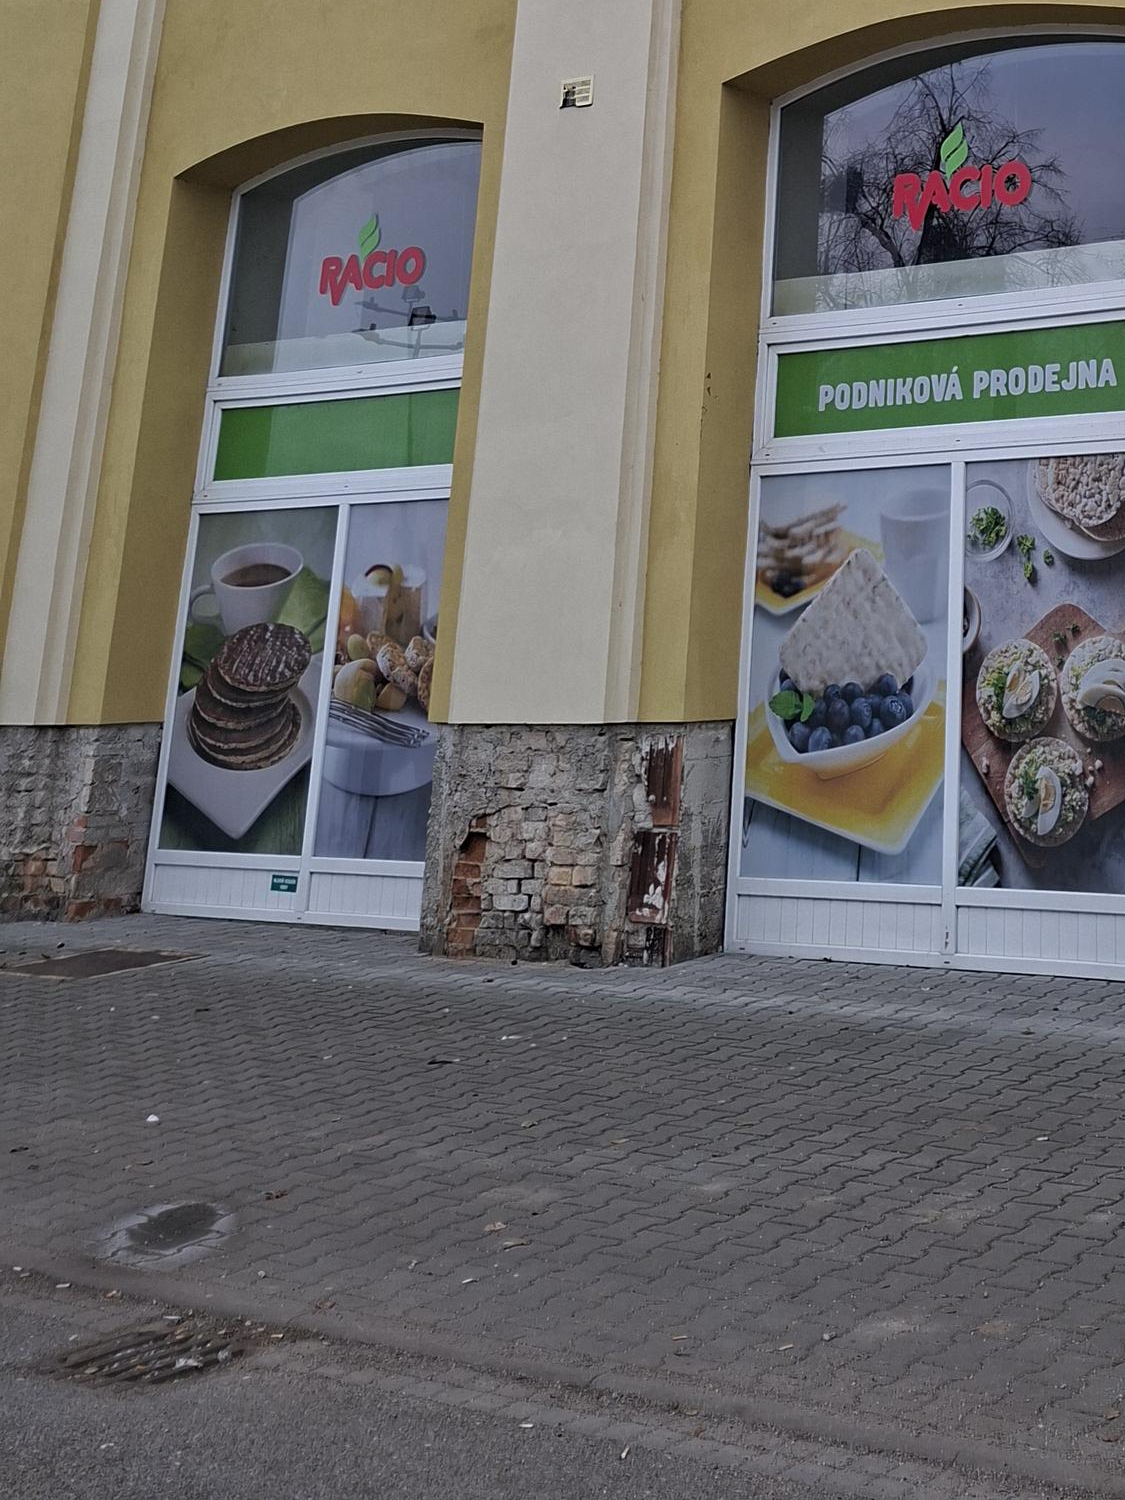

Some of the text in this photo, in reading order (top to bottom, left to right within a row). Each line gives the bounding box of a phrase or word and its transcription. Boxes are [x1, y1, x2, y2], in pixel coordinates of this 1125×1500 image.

[893, 160, 1032, 232] RACIO
[319, 245, 426, 306] RACIO
[818, 358, 1118, 412] PODNIKOVÁ PRODEJNA
